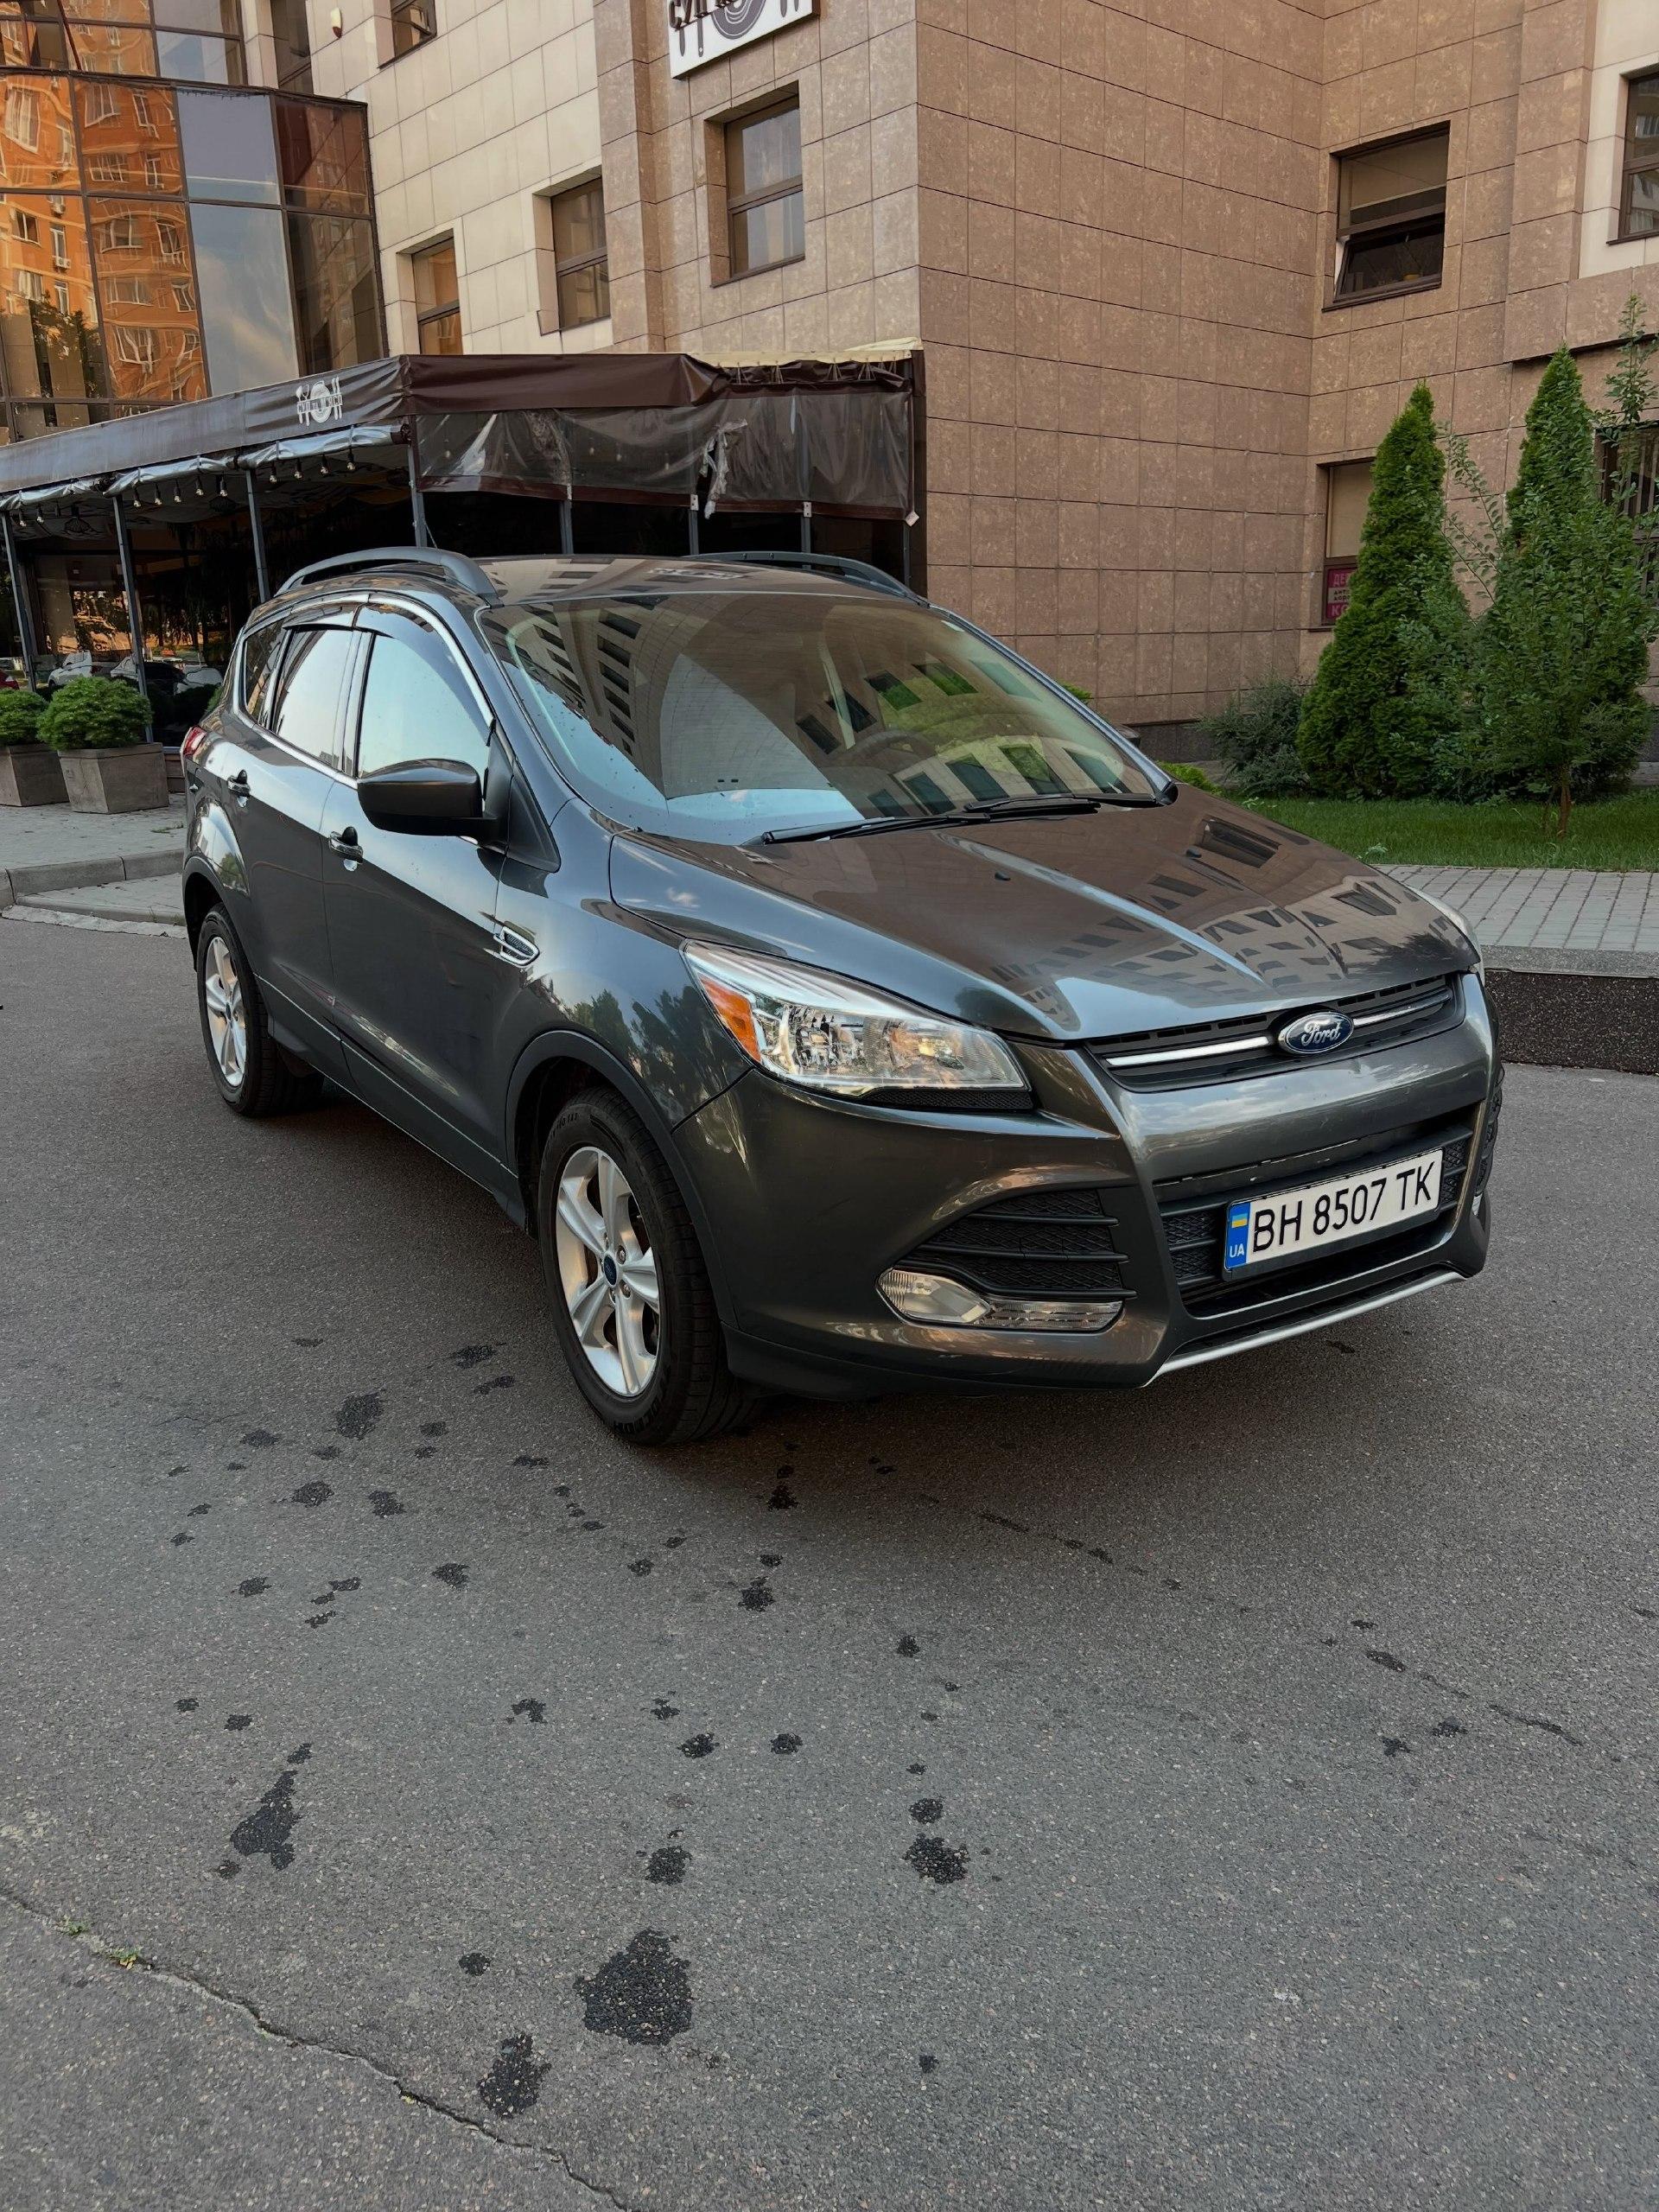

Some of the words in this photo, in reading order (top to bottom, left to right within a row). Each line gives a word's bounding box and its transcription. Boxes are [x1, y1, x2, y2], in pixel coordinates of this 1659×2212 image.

[1300, 1019, 1342, 1046] Ford
[1253, 1201, 1302, 1253] BH
[1313, 1179, 1387, 1236] 8507
[1396, 1162, 1435, 1211] TK
[1229, 1245, 1245, 1258] UA
